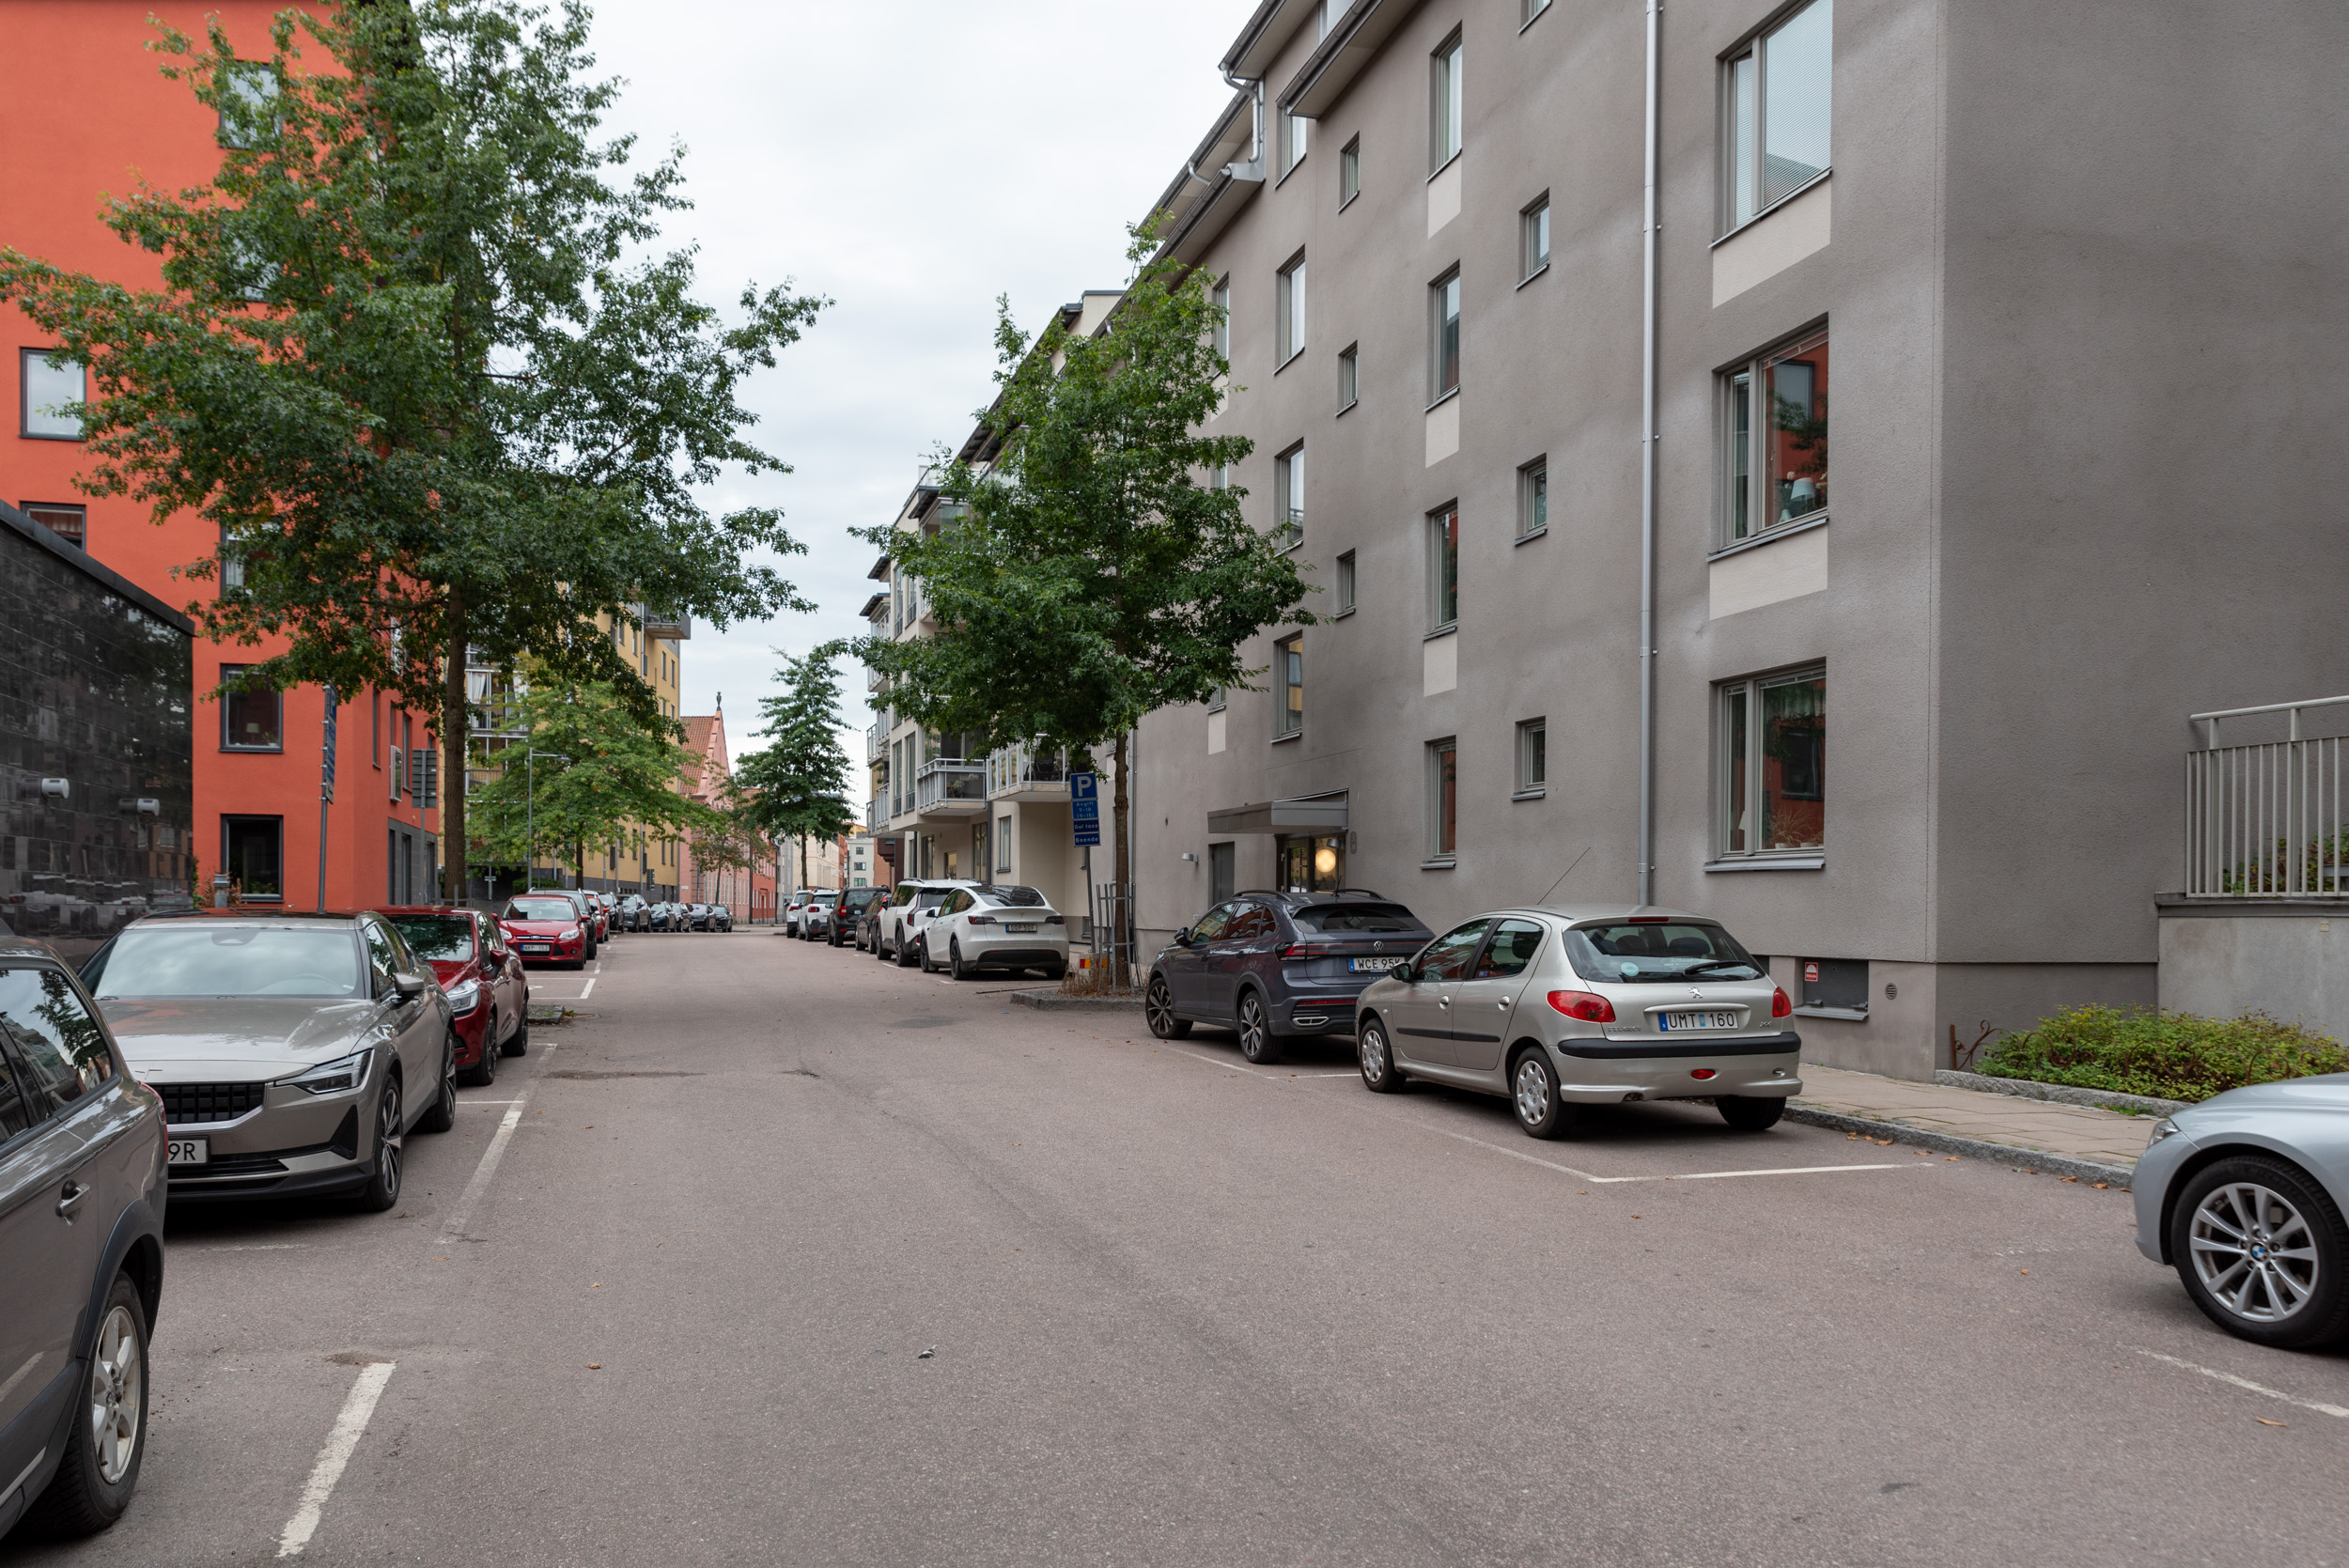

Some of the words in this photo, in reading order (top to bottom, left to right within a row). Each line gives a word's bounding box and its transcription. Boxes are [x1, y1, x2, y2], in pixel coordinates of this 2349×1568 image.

[1077, 776, 1092, 797] P
[1358, 958, 1378, 969] WCE
[1669, 1014, 1696, 1028] UMT
[1709, 1013, 1735, 1027] 160
